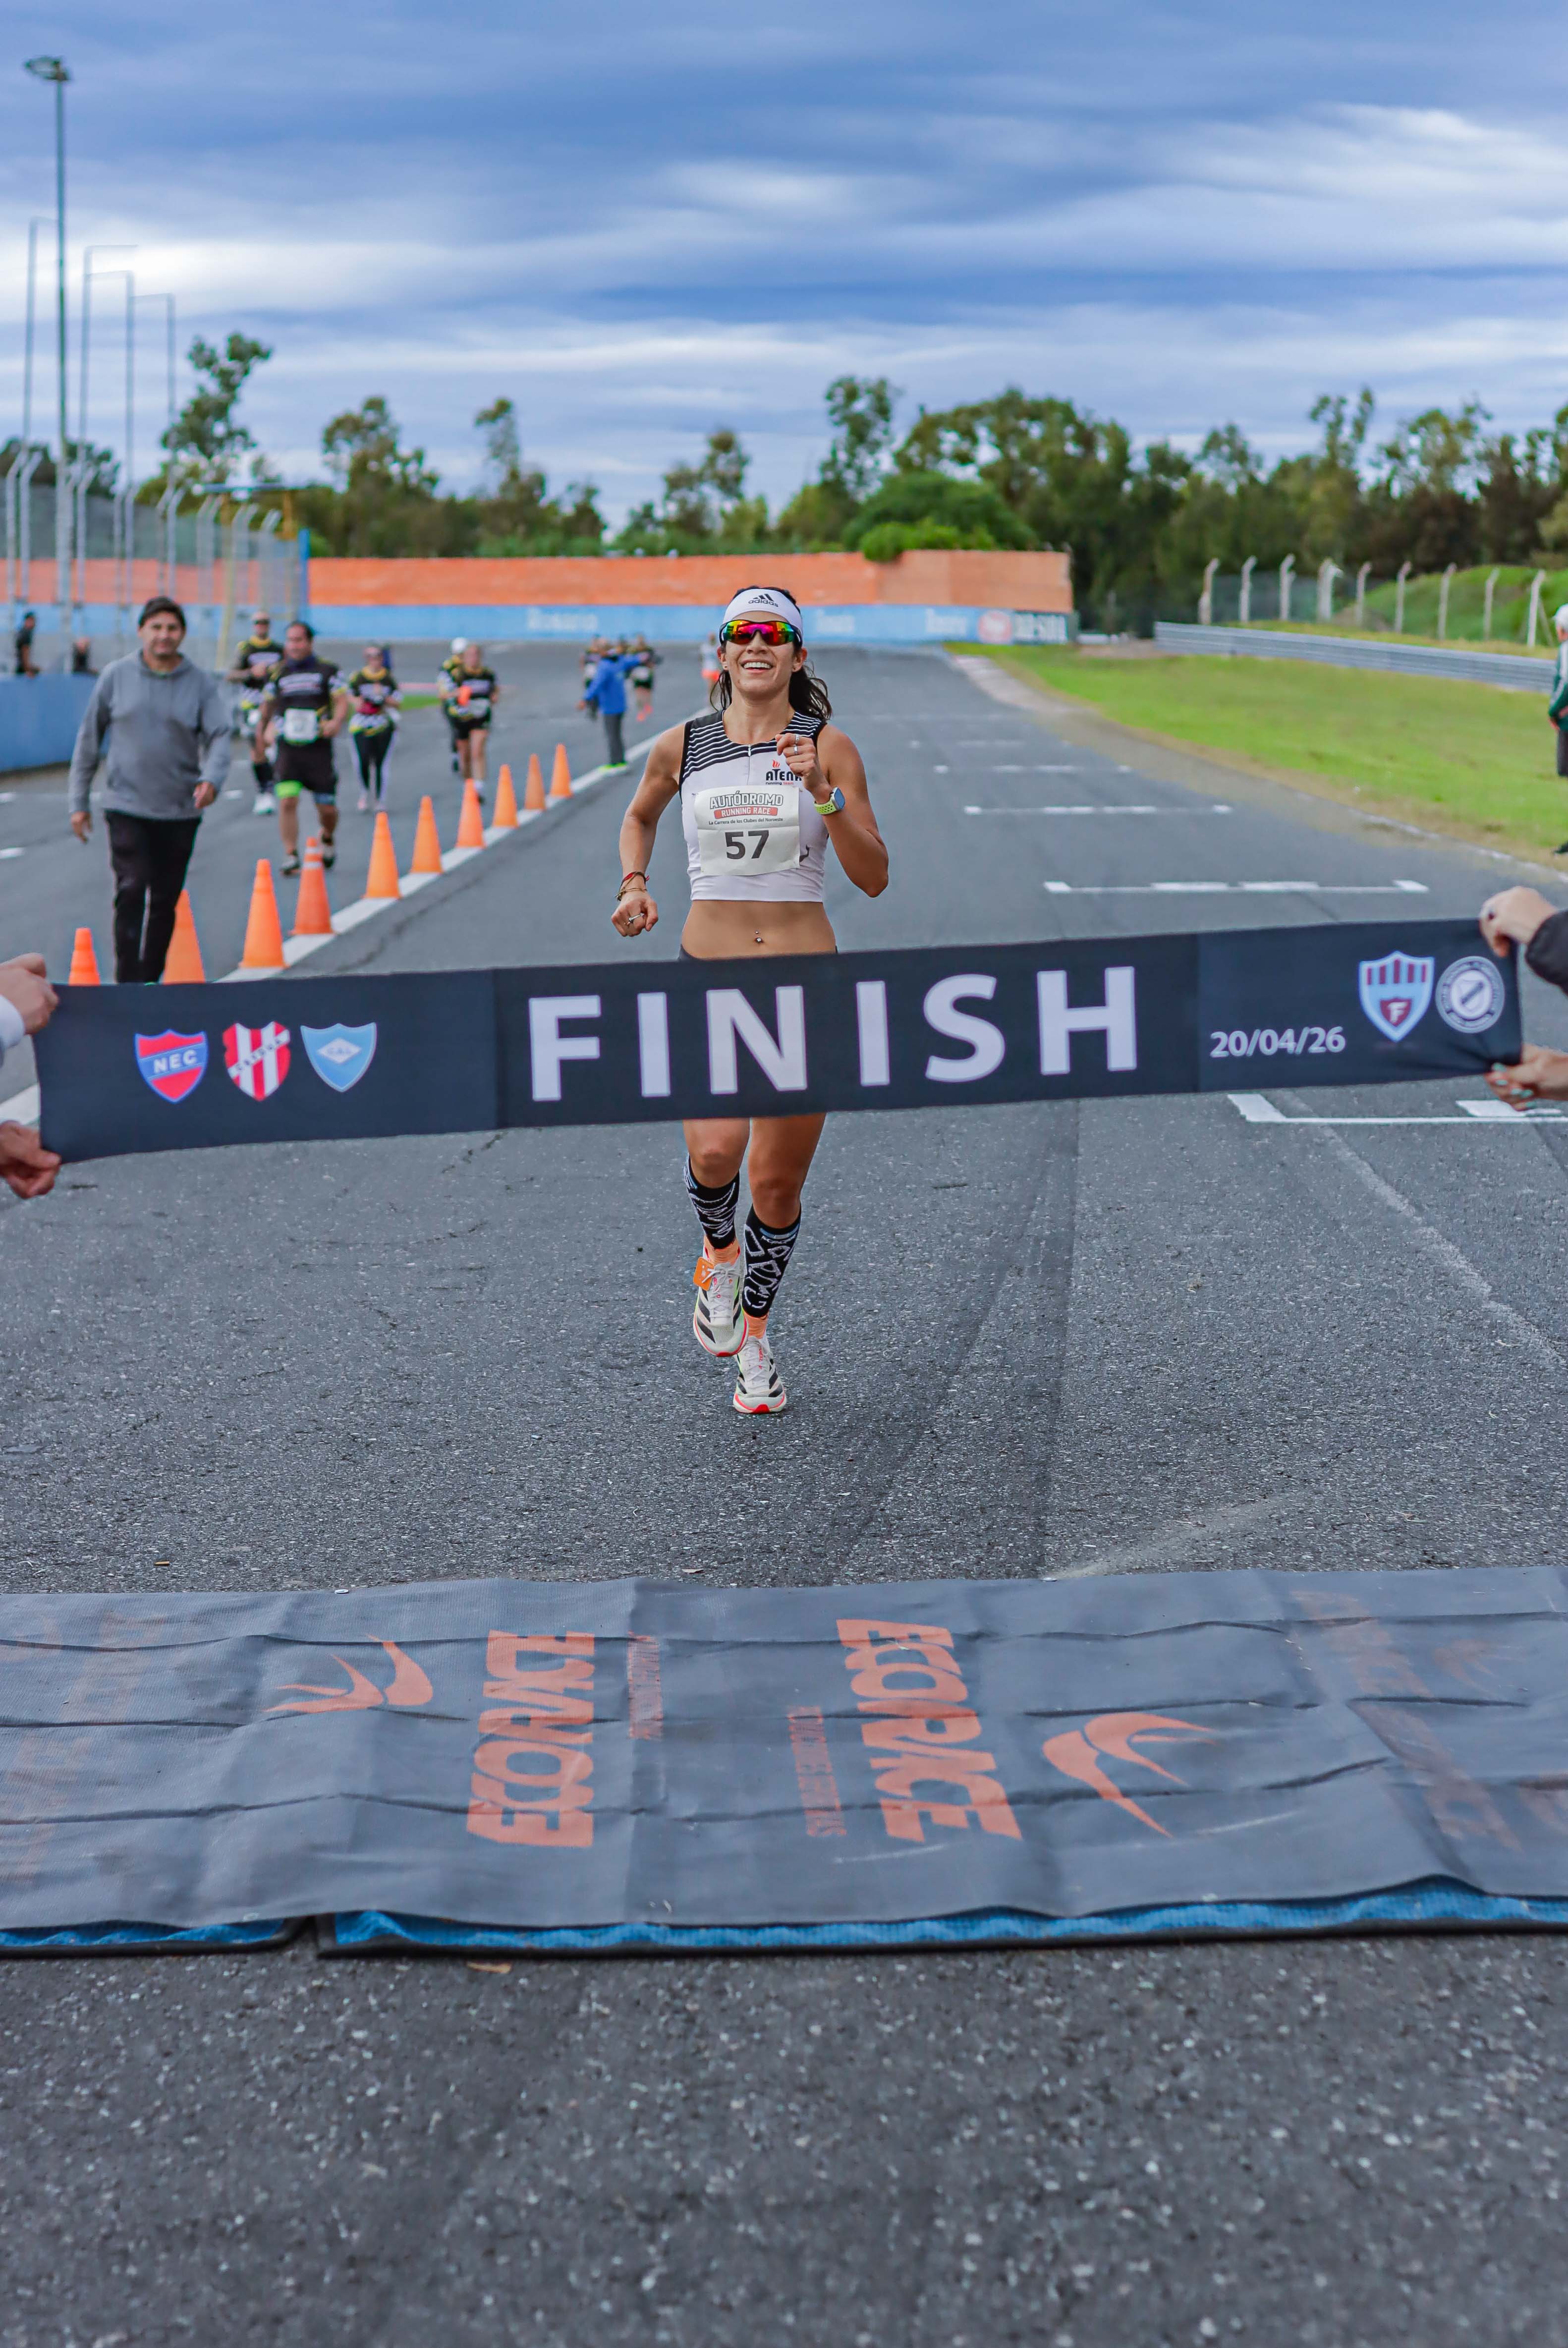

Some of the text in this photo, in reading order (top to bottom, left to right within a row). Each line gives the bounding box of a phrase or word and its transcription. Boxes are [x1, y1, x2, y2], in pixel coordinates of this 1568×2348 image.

[748, 599, 778, 607] adidas
[710, 790, 784, 809] AUTÓDROMO
[721, 807, 751, 817] RUNNING
[725, 830, 769, 859] 57
[529, 966, 1137, 1101] FINISH
[1210, 1026, 1345, 1058] 20/04/26
[154, 1050, 197, 1073] NEC
